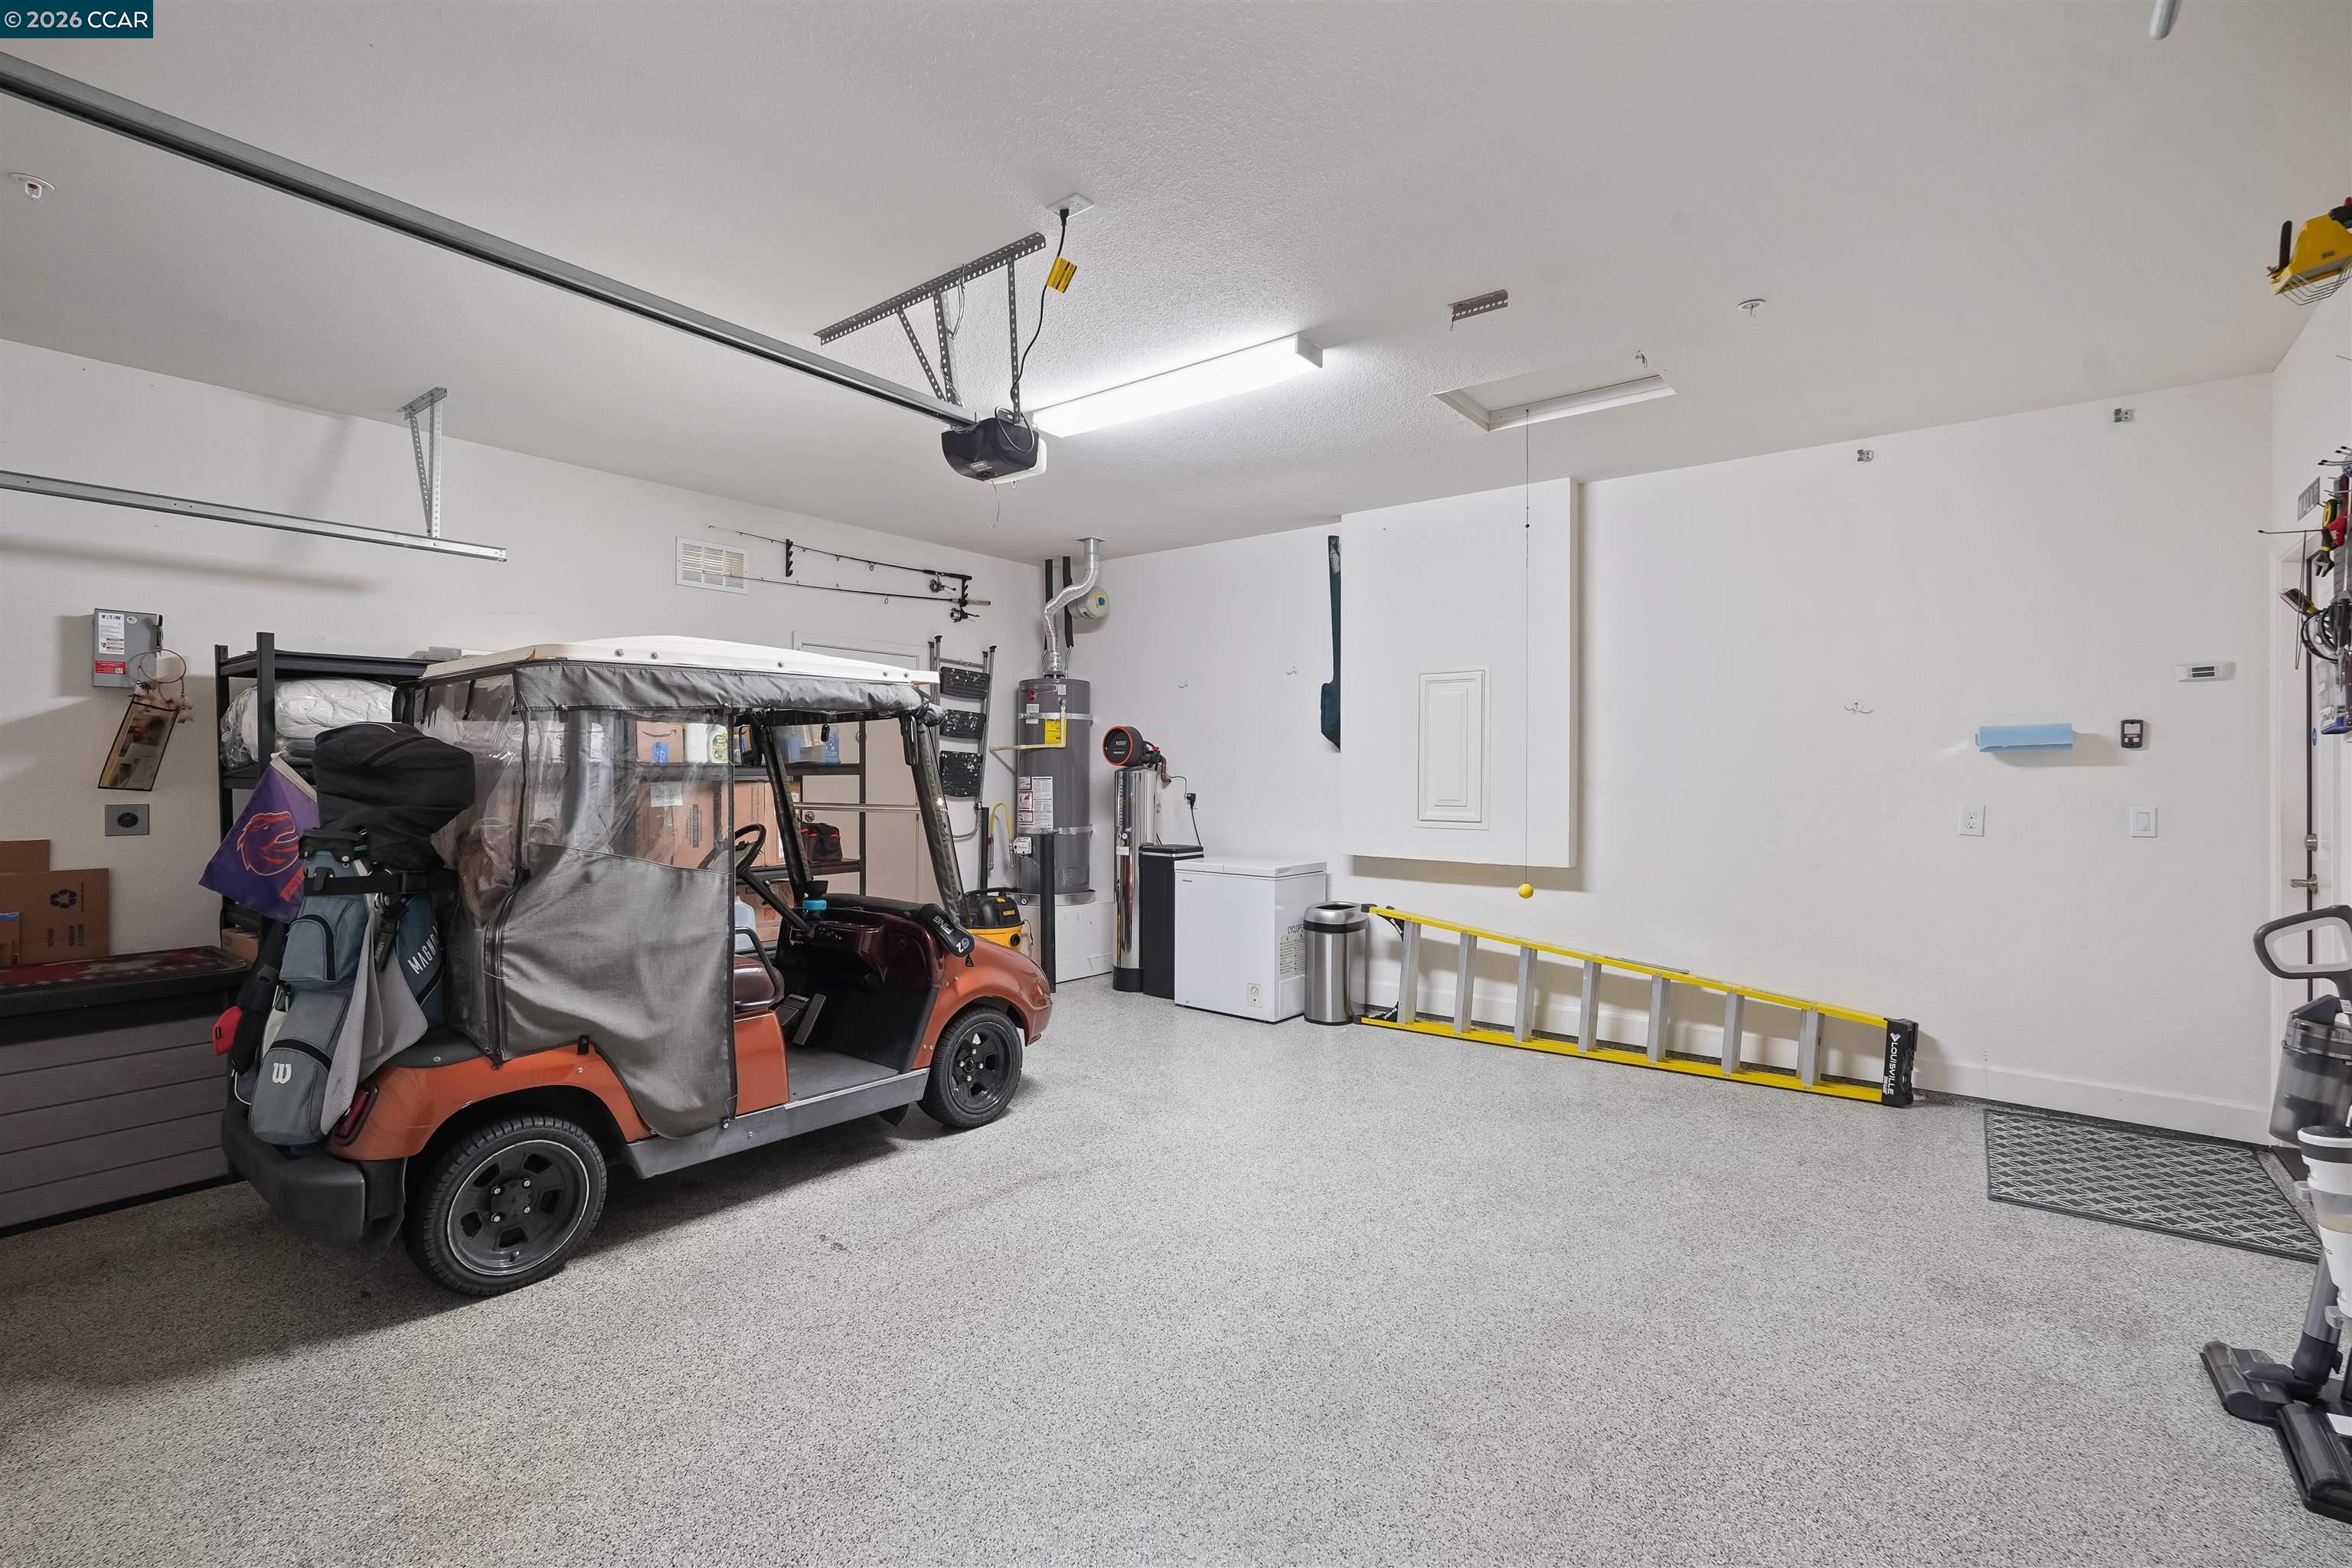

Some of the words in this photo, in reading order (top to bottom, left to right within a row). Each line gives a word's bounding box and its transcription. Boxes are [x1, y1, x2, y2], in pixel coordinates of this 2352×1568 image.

[933, 915, 954, 935] PING
[1287, 923, 1305, 935] CYCLOPE
[1887, 1042, 1899, 1096] LOUISVILLE
